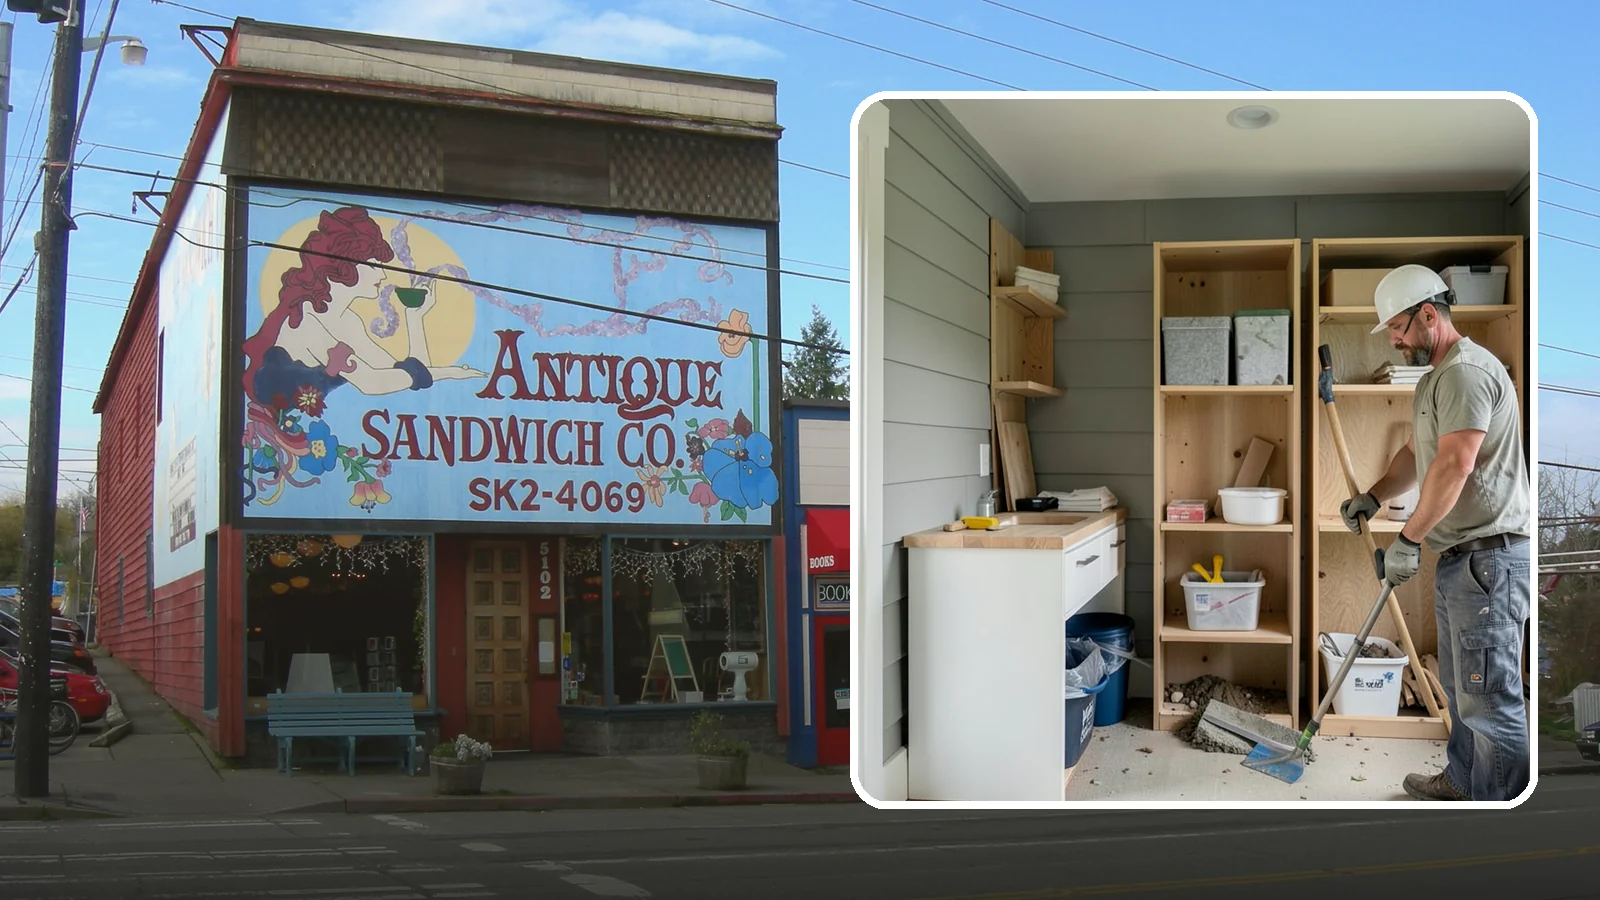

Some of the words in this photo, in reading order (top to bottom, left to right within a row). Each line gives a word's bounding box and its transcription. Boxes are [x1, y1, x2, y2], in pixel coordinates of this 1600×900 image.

[476, 329, 723, 420] ANTIQUE
[361, 408, 604, 467] SANDWICH
[617, 422, 685, 468] CO.
[468, 478, 645, 513] SK2-4069
[540, 541, 551, 600] 5102
[809, 555, 834, 569] BOOKS
